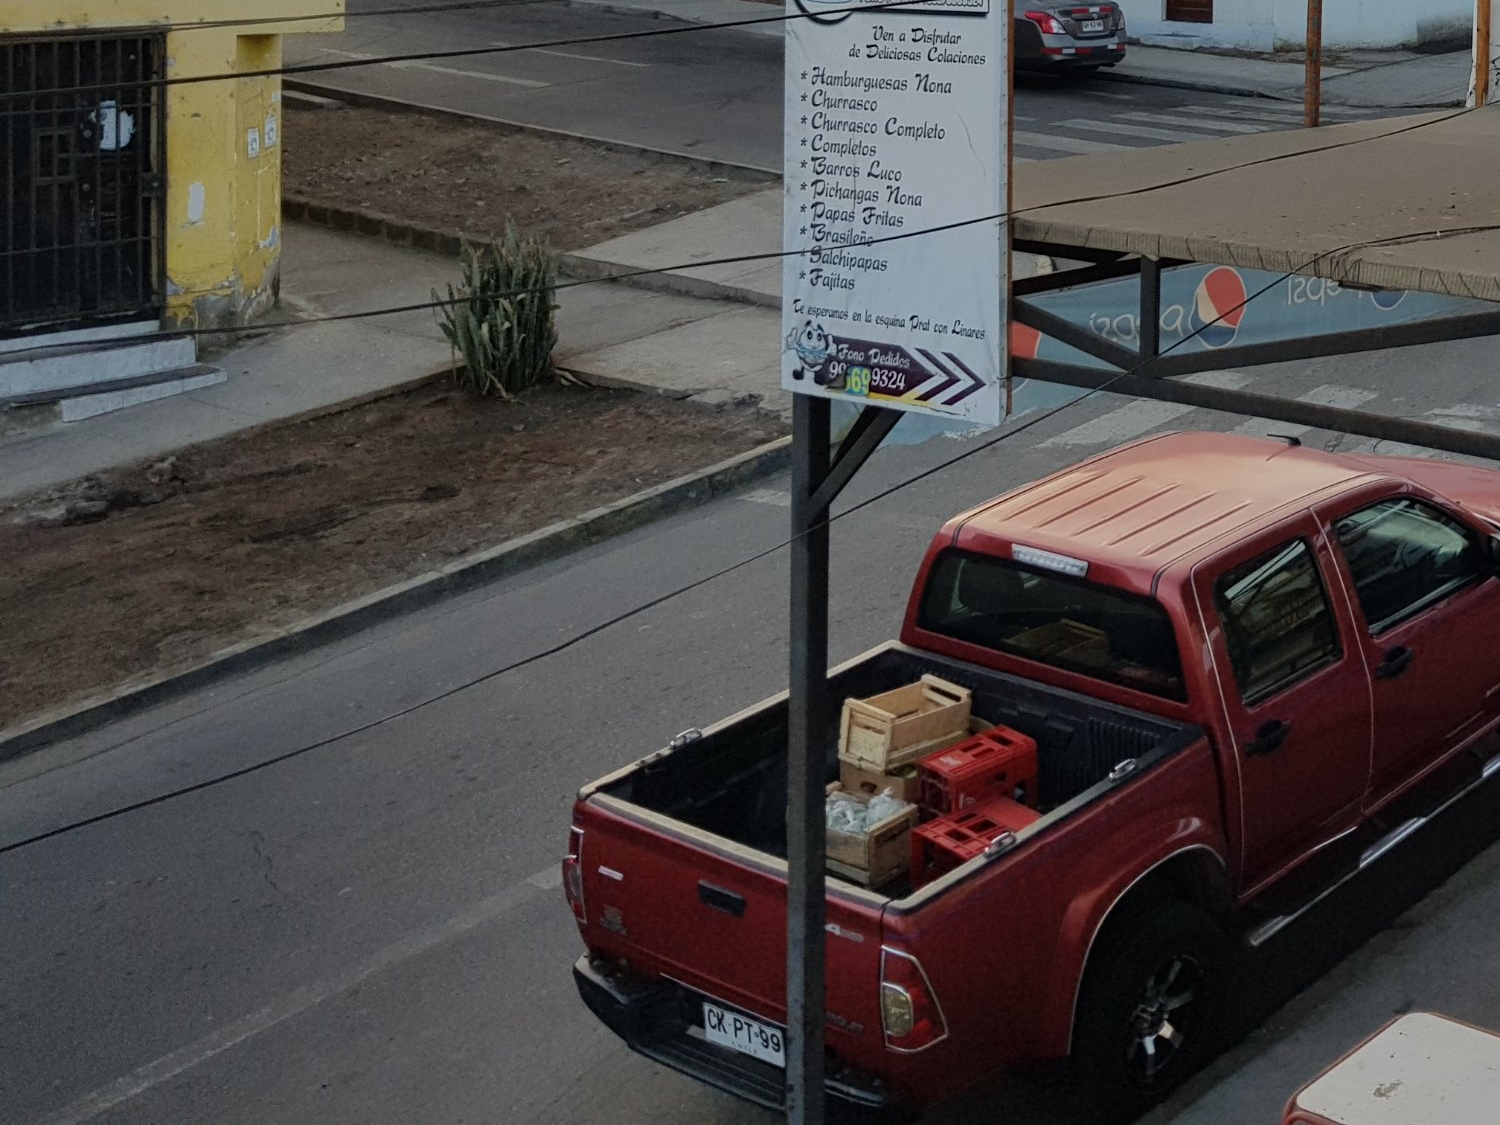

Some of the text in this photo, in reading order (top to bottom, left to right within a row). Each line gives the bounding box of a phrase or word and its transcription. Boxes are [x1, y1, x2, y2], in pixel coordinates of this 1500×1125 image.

[872, 26, 962, 46] Ven a Disfrutar
[849, 44, 986, 65] de Deliciosas Colaciones
[811, 66, 952, 94] Hamburguesas Nona
[811, 89, 878, 112] Churrasco
[811, 112, 946, 140] Churrasco Completo
[811, 134, 877, 157] Completos
[811, 156, 902, 182] Barros Luco
[811, 179, 922, 207] Pichangas Nona
[811, 201, 904, 228] Papas Fritas
[809, 245, 888, 272] Salchipapas
[810, 268, 856, 291] Fajitas
[793, 299, 986, 340] Te esperamos en la esquina Prat con Linares
[837, 344, 911, 369] Fono Pedidos
